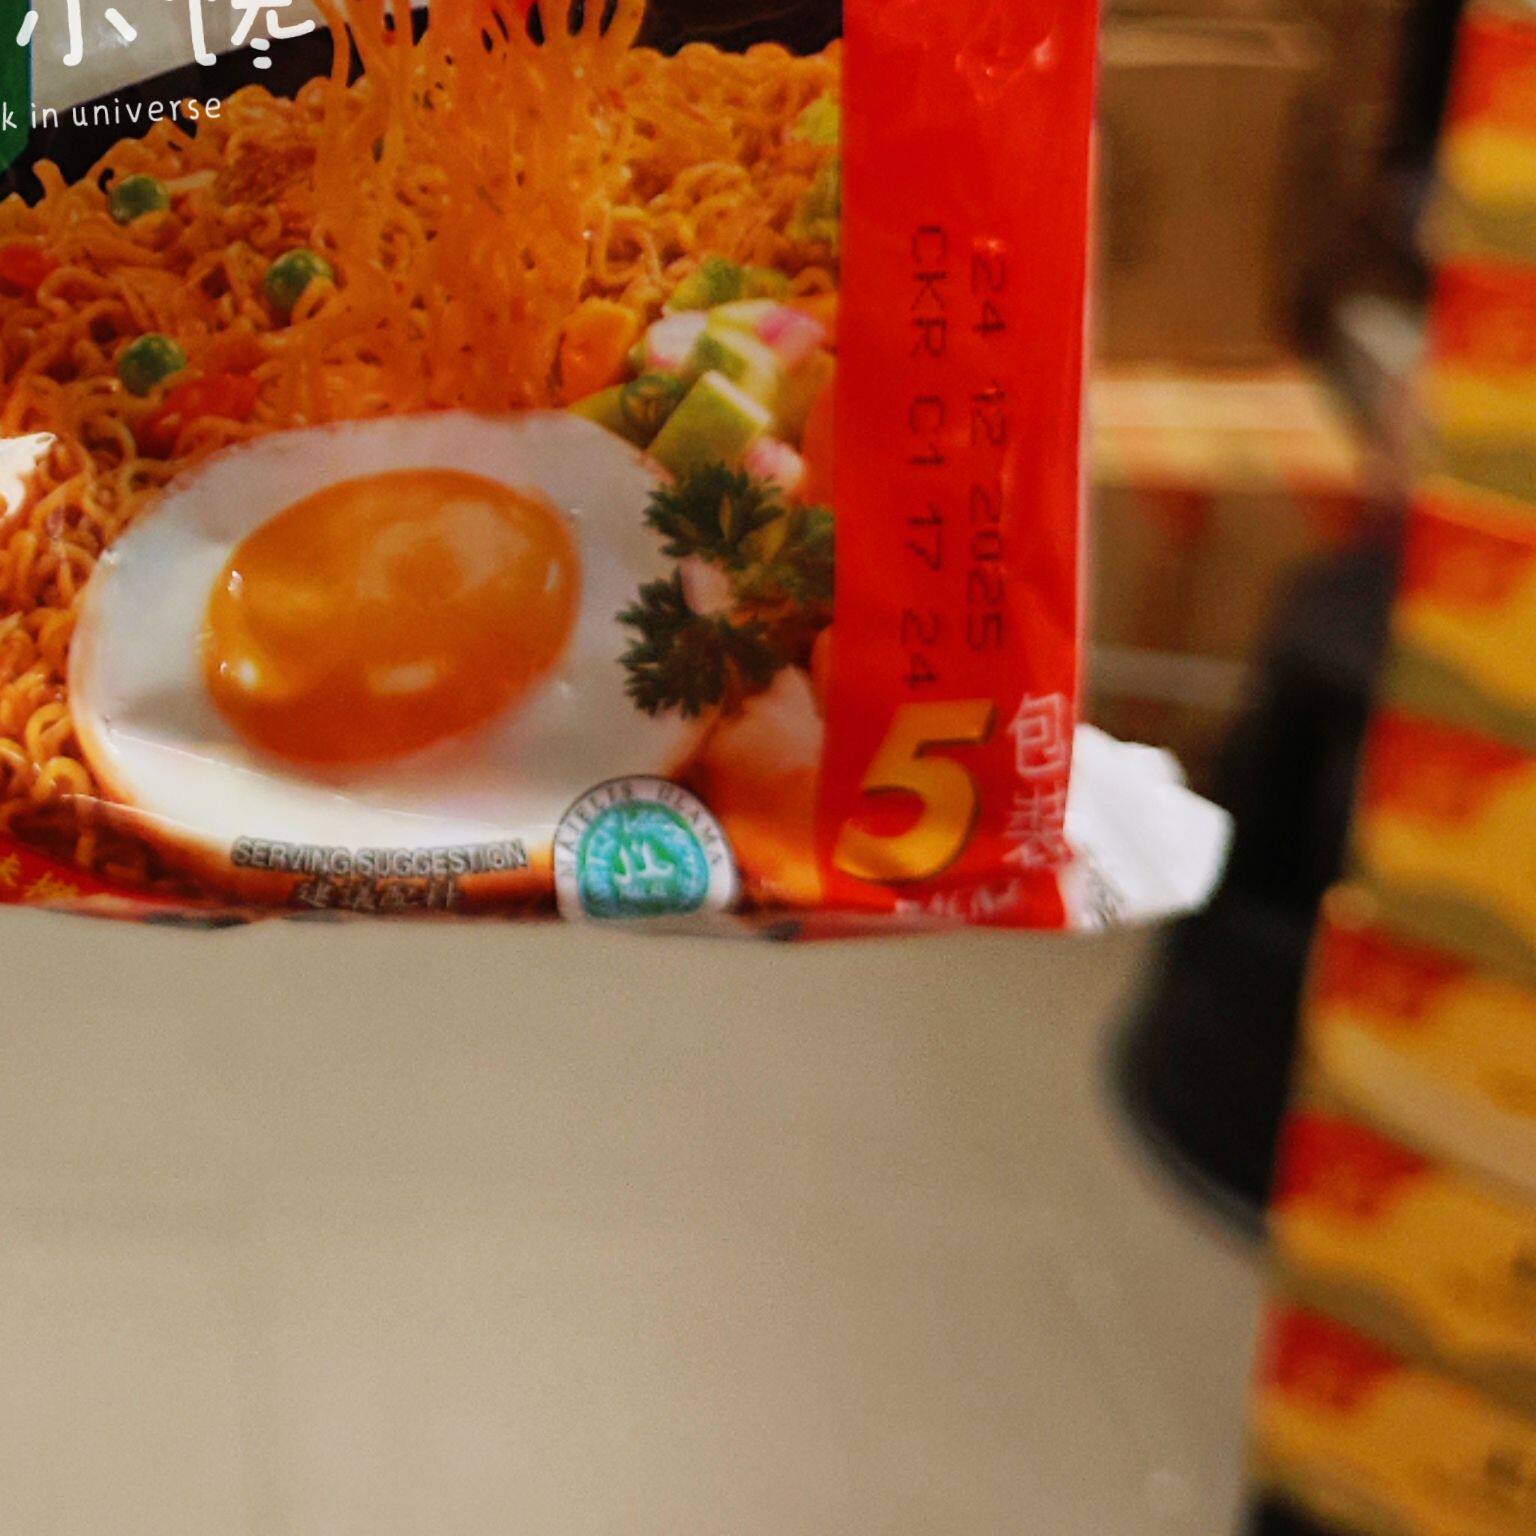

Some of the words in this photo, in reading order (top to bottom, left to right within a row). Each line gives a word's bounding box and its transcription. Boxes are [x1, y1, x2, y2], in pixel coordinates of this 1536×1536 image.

[910, 224, 948, 359] CKR
[966, 482, 1006, 652] 2025
[230, 835, 354, 876] SERVING
[354, 837, 530, 877] SUGGESTION
[832, 696, 998, 890] 5
